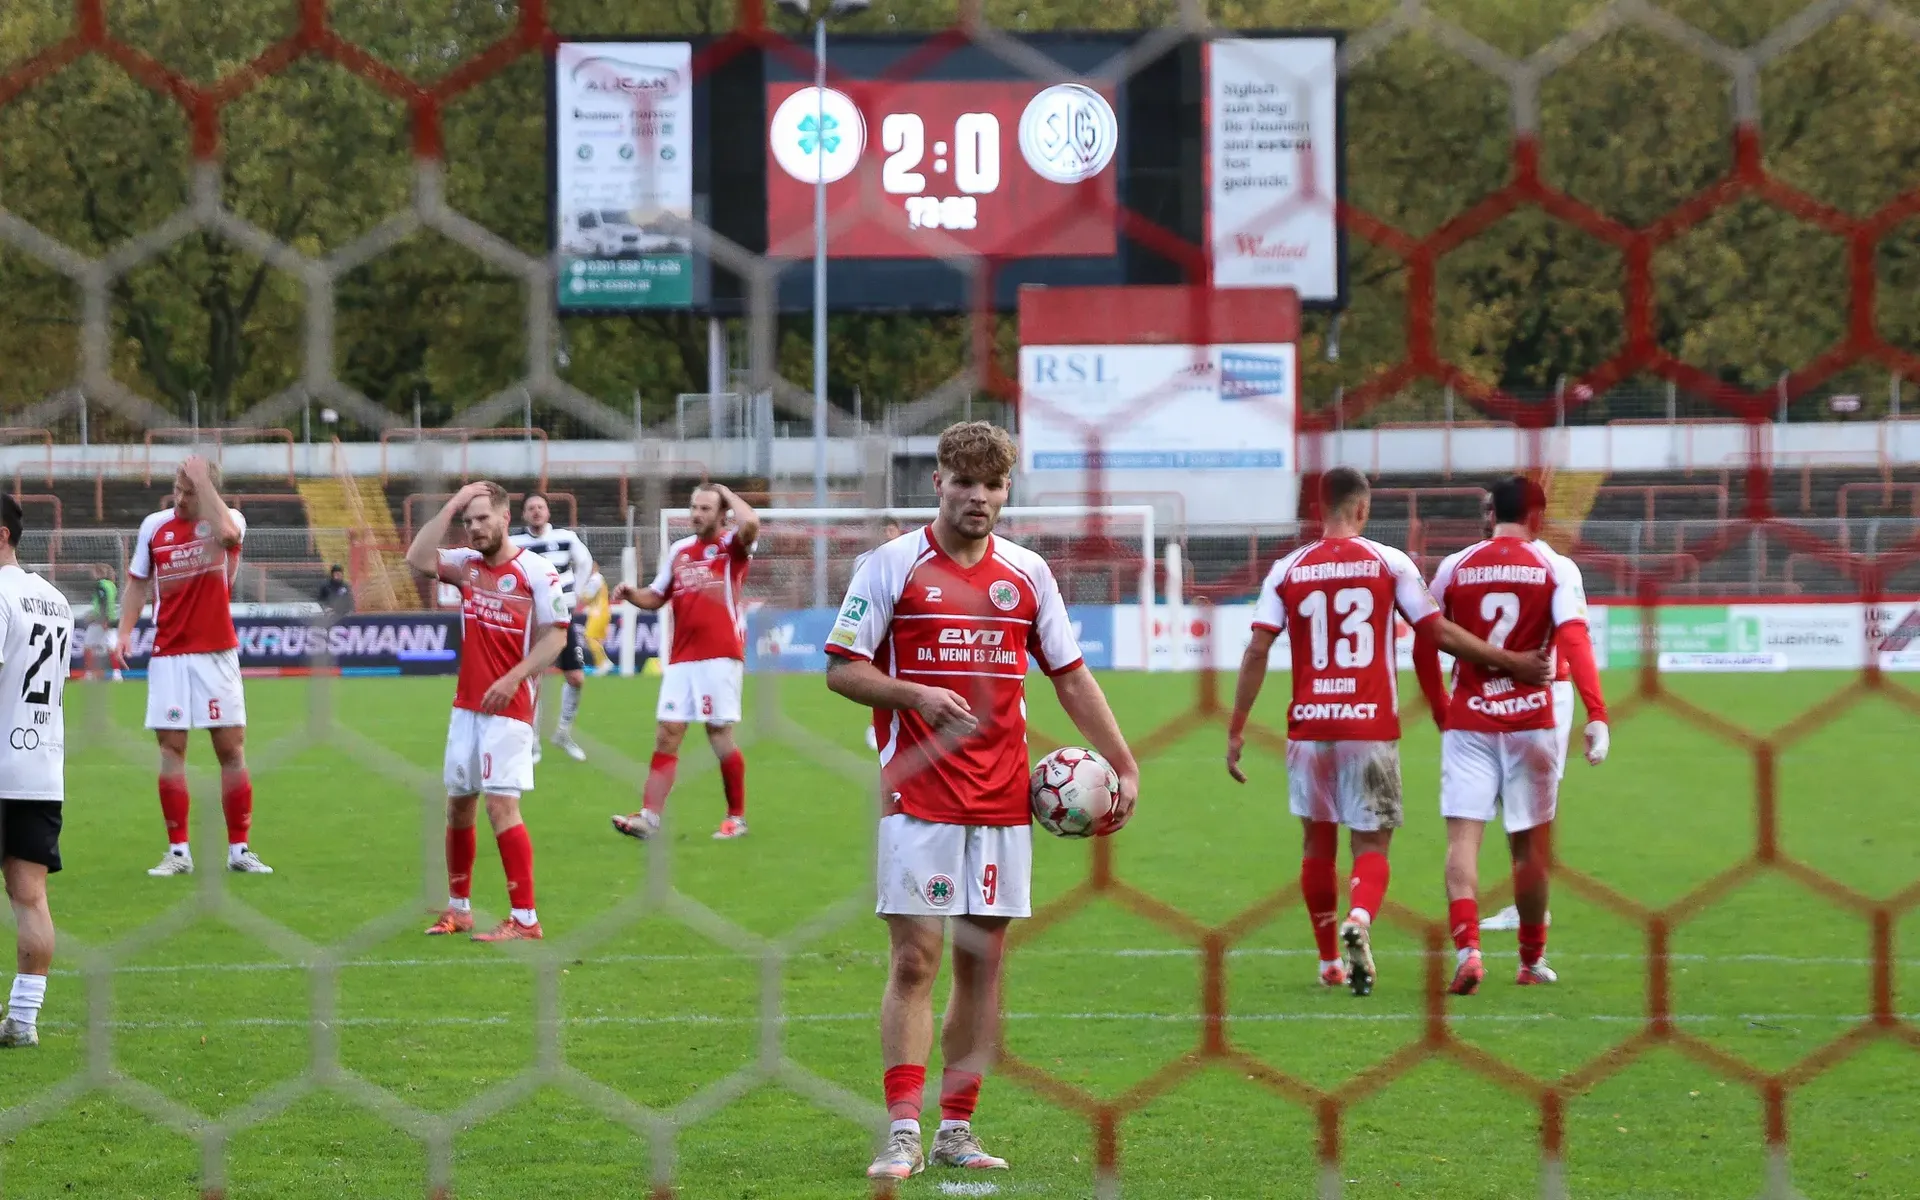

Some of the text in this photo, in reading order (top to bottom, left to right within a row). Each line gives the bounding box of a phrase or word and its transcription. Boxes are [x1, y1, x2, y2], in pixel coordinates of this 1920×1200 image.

[882, 112, 1000, 194] 2:0
[1034, 353, 1118, 382] RSL
[1291, 560, 1380, 584] OBERHAUSEN
[1458, 565, 1546, 586] OBERHAUSEN
[1298, 587, 1374, 671] 13
[1481, 592, 1520, 650] 2
[938, 628, 1004, 646] evo
[22, 622, 67, 707] 21
[917, 647, 936, 662] DA,
[940, 648, 970, 662] WENN
[974, 649, 985, 662] ES
[1293, 703, 1378, 720] CONTACT
[1467, 690, 1548, 716] CONTACT
[982, 863, 998, 905] 9
